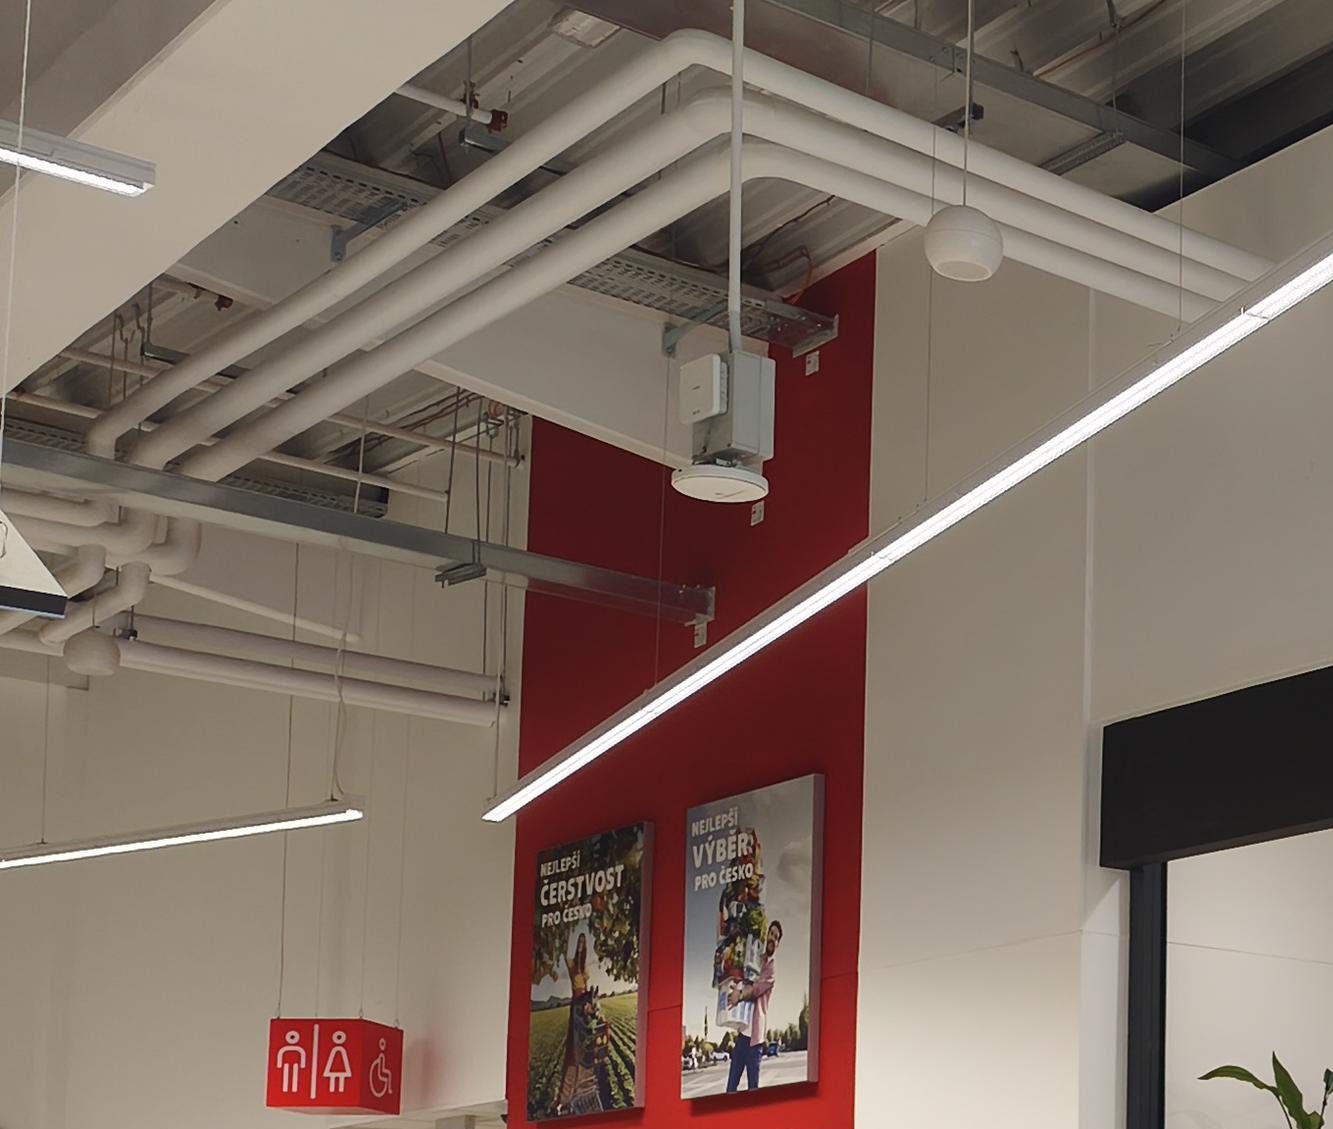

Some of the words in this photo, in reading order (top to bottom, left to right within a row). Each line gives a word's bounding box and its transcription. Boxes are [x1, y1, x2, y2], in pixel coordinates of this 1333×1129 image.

[691, 806, 738, 837] NEJLEPŠÍ
[692, 827, 749, 868] VÝBĚR
[540, 850, 580, 877] NEJLEPŠÍ
[694, 874, 717, 892] PRO
[719, 861, 753, 885] ČESKO
[540, 863, 625, 906] ČERSTVOST
[541, 911, 561, 929] PRO
